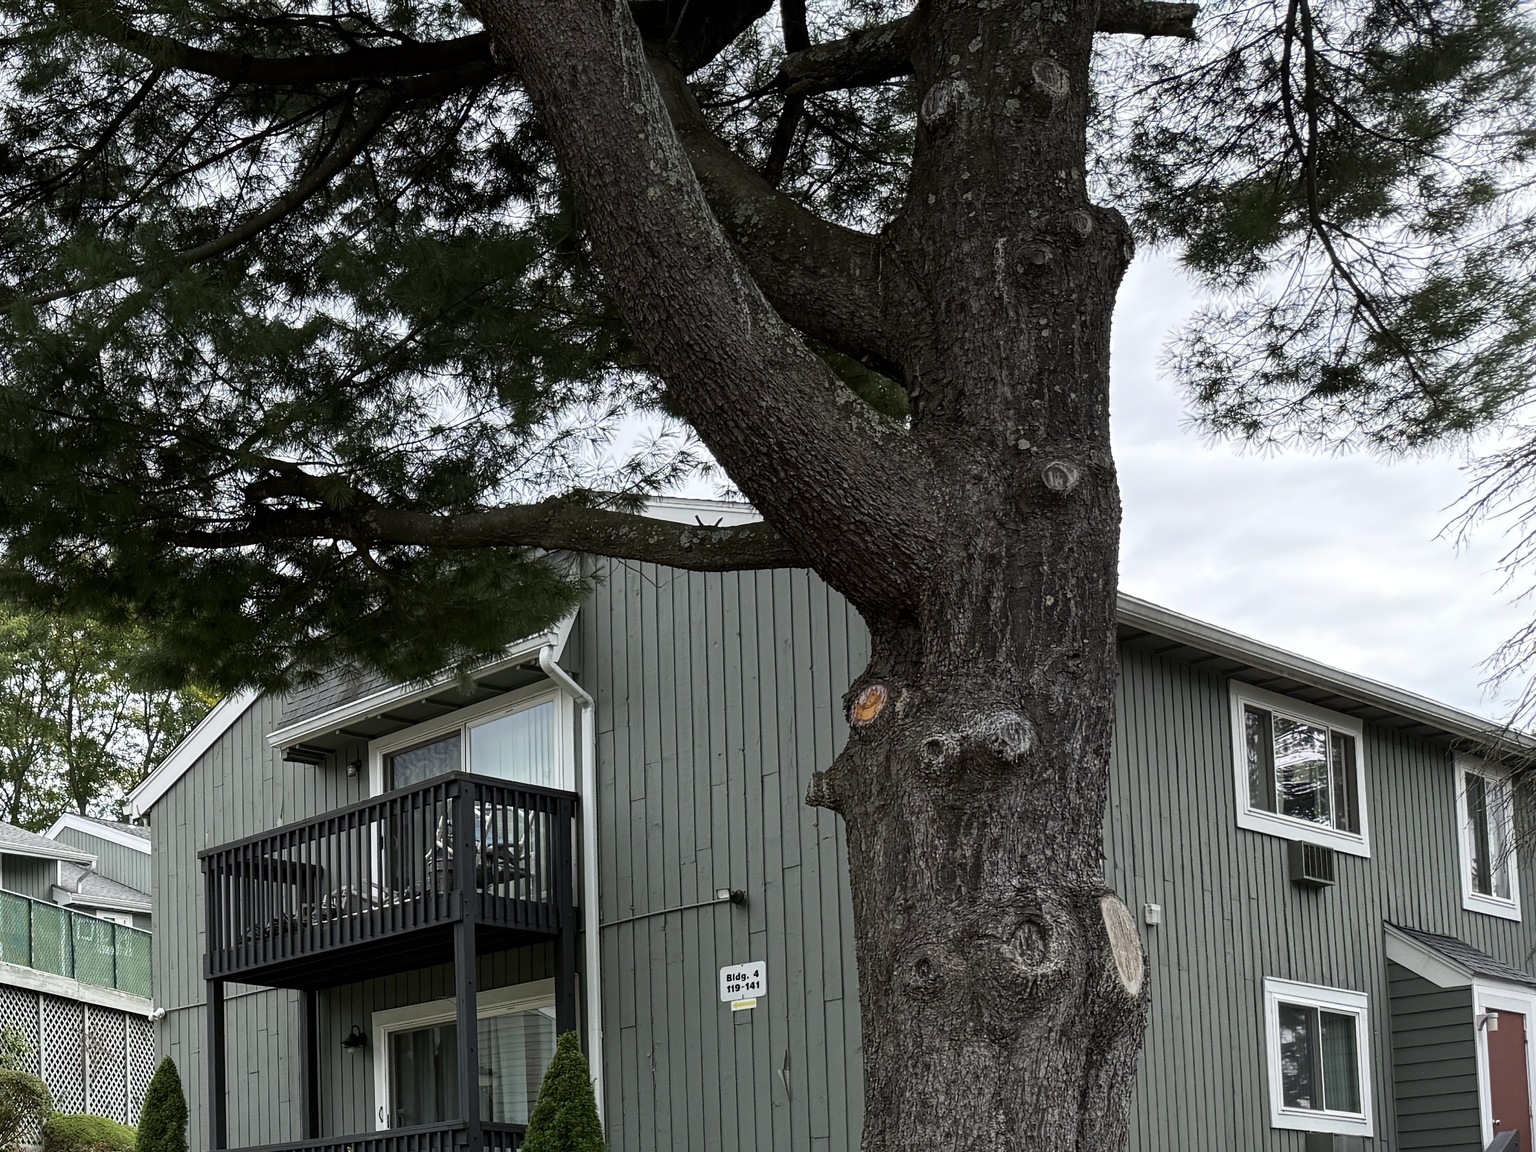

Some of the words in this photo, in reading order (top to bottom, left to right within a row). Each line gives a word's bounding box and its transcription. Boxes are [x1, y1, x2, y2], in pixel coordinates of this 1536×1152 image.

[726, 972, 750, 982] Bldg.
[753, 969, 760, 978] 4
[726, 980, 760, 993] 119-141
